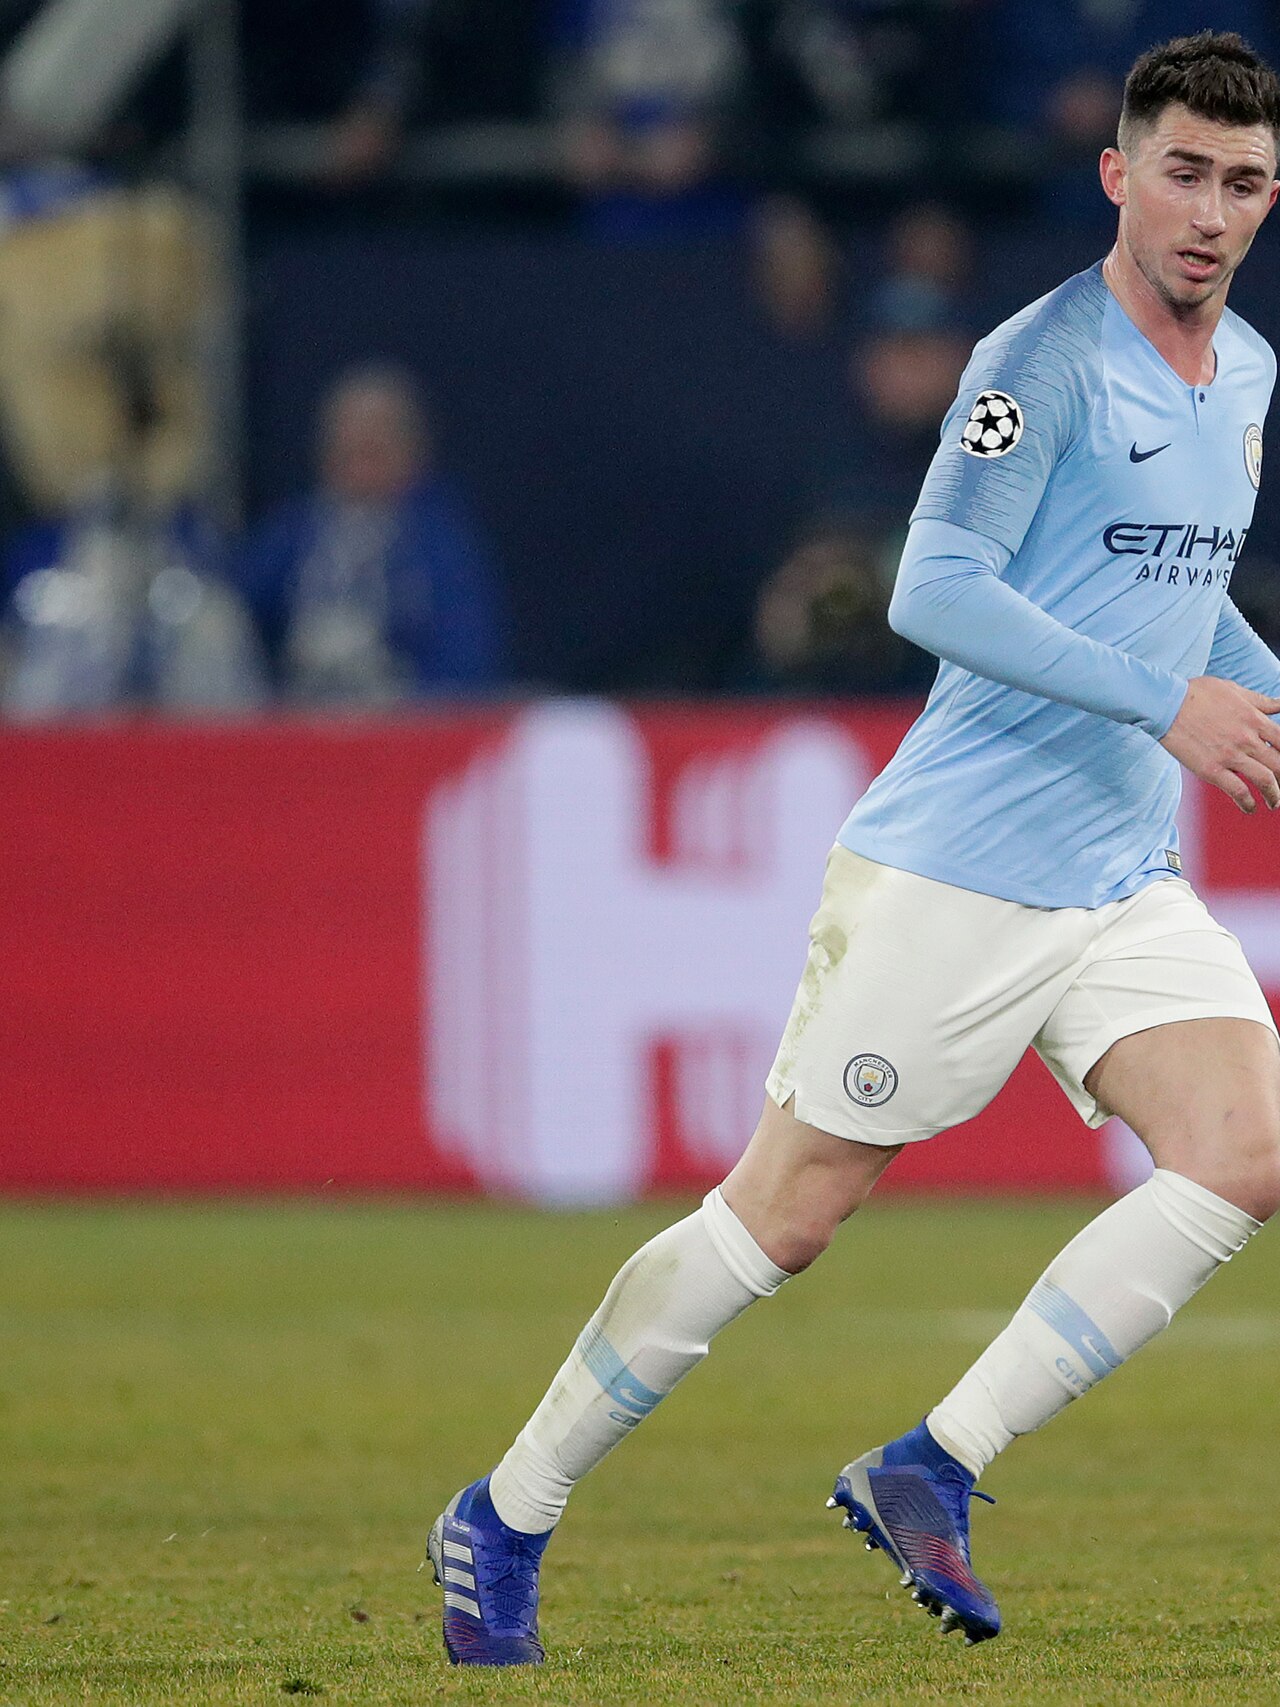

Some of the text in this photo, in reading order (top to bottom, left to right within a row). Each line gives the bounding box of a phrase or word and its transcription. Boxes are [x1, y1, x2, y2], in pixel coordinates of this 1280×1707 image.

[1135, 562, 1231, 589] AIRWAYS
[854, 1058, 893, 1079] MANCHESTER
[858, 1095, 873, 1103] CITY
